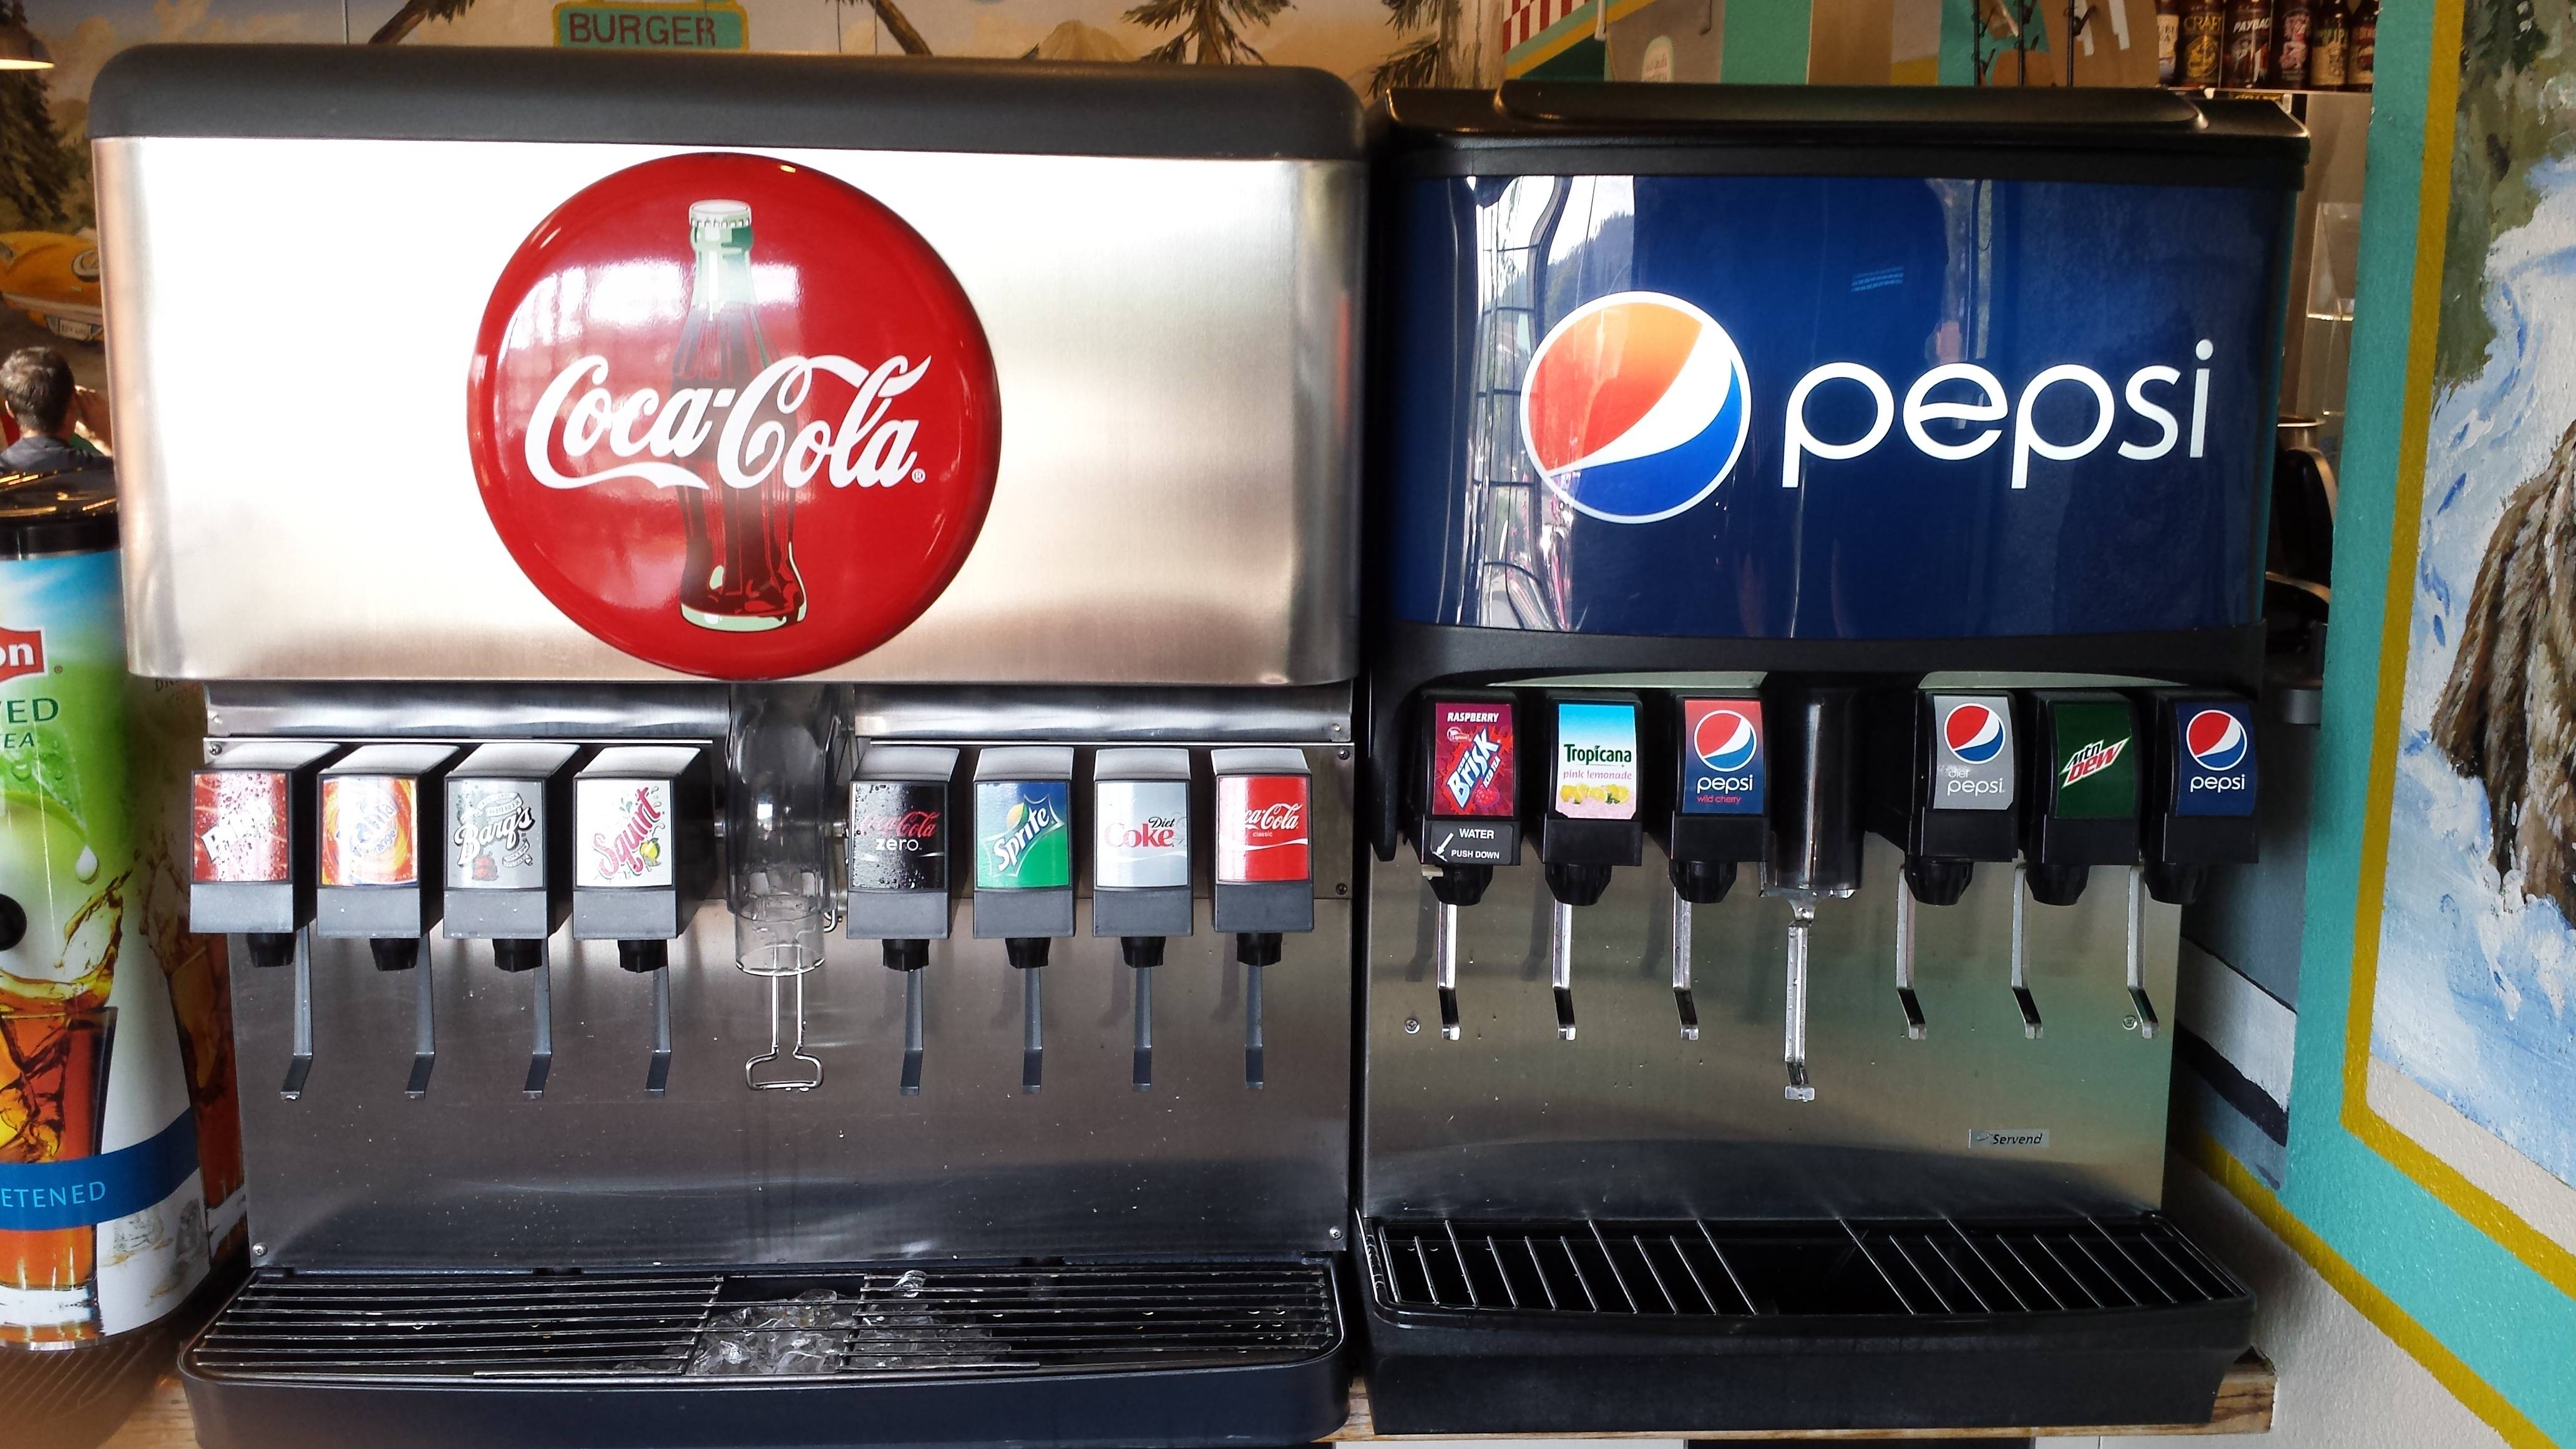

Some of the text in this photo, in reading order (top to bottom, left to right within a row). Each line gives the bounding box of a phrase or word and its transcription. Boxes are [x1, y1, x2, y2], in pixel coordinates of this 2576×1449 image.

[568, 12, 716, 46] BURGER
[525, 354, 932, 489] Coca-Cola
[1782, 339, 2214, 489] pepsi
[0, 698, 59, 724] ED
[1447, 712, 1500, 722] RASPBERRY
[0, 733, 36, 748] EA
[1564, 744, 1632, 765] Tropicana
[1491, 756, 1501, 772] TEA
[1563, 769, 1632, 779] pink lemonade
[1948, 768, 1970, 779] diet
[1697, 774, 1753, 794] pepsi
[1947, 778, 2003, 796] pepsi
[2190, 774, 2245, 793] pepsi
[1697, 795, 1742, 805] wild cherry
[1148, 816, 1175, 829] Diet
[454, 806, 535, 867] Barq's
[593, 788, 660, 878] Squirt
[993, 807, 1050, 872] Sprite
[1104, 823, 1175, 847] Coke
[1459, 828, 1495, 839] WATER
[369, 829, 396, 856] orange
[876, 839, 919, 852] zero
[1451, 849, 1500, 859] PUSH DOWN
[1992, 1133, 2043, 1144] Servend
